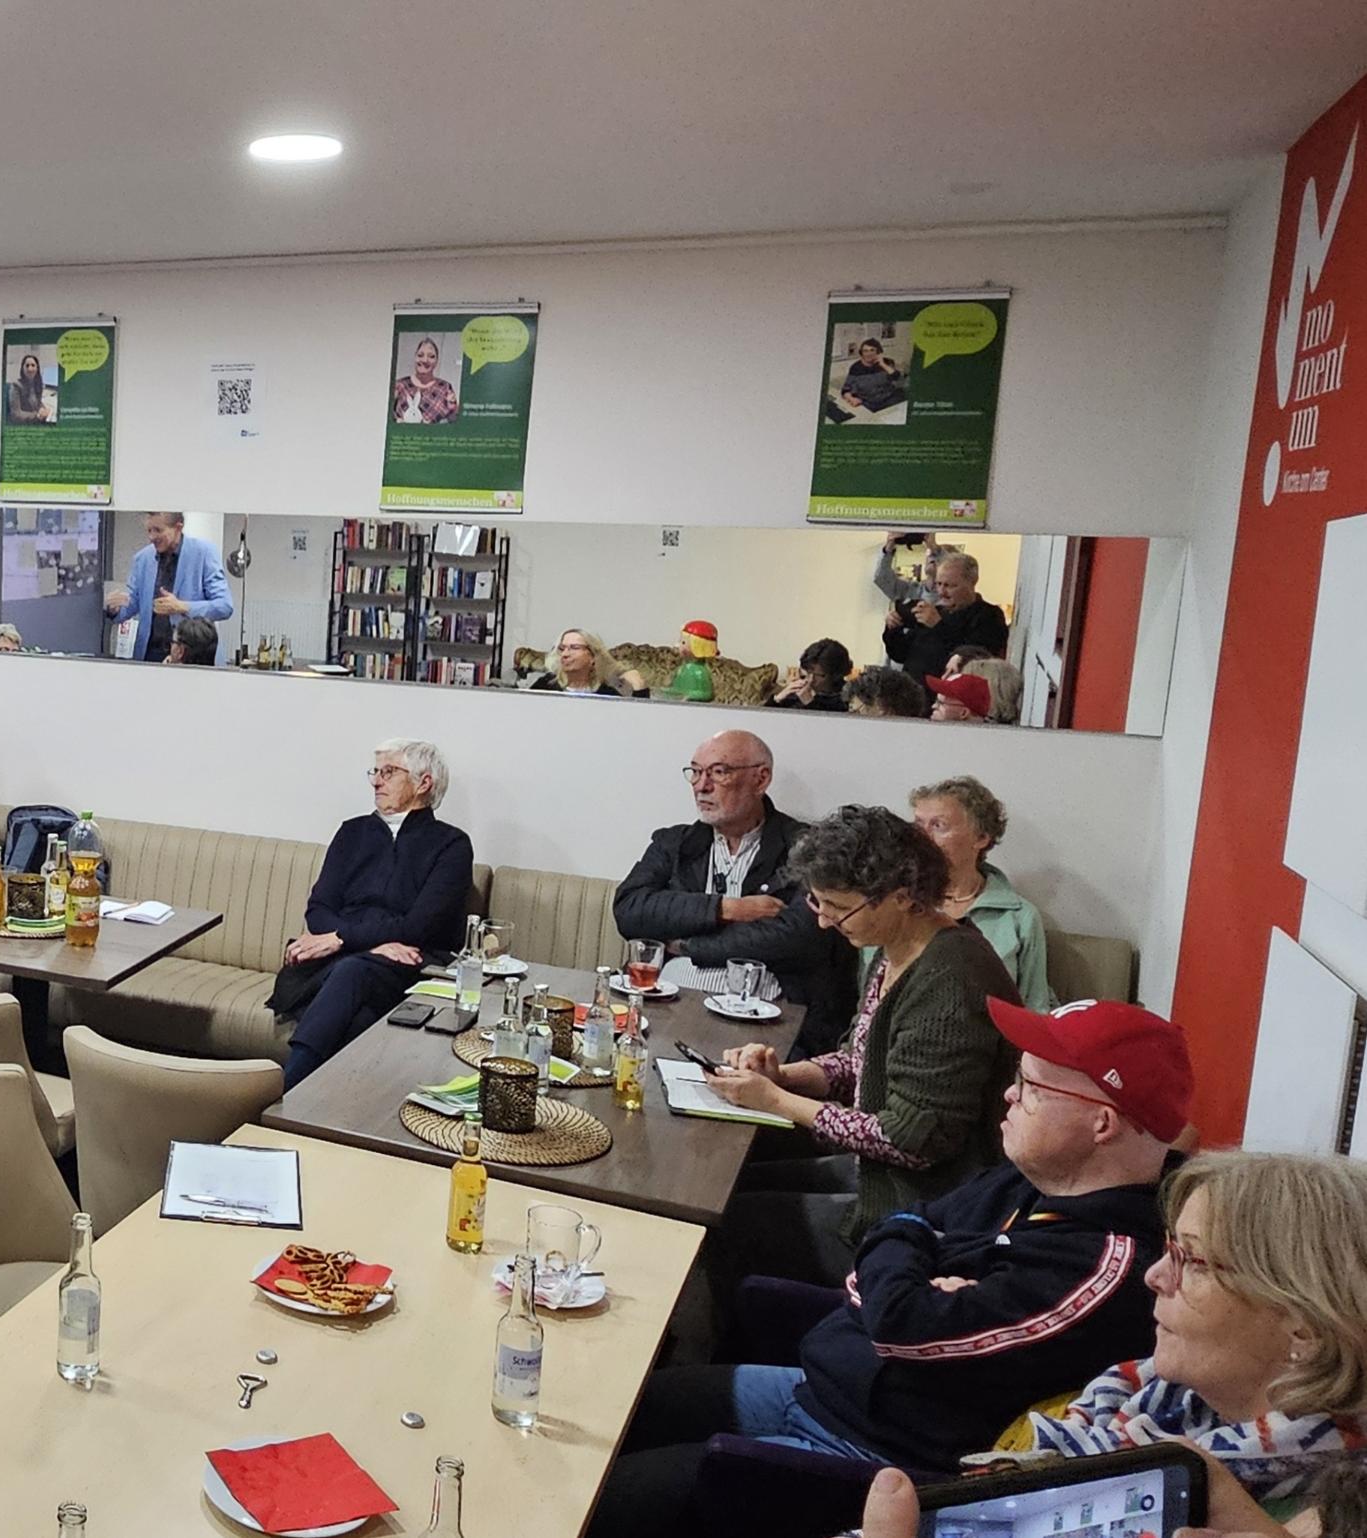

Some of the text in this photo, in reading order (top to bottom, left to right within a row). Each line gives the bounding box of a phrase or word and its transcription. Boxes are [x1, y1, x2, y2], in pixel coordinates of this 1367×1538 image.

[1302, 299, 1335, 351] mo
[1294, 327, 1349, 402] ment
[1288, 405, 1320, 452] um
[387, 493, 493, 508] Hoffnungsmenschen
[815, 503, 948, 518] Hoffnungsmenschen
